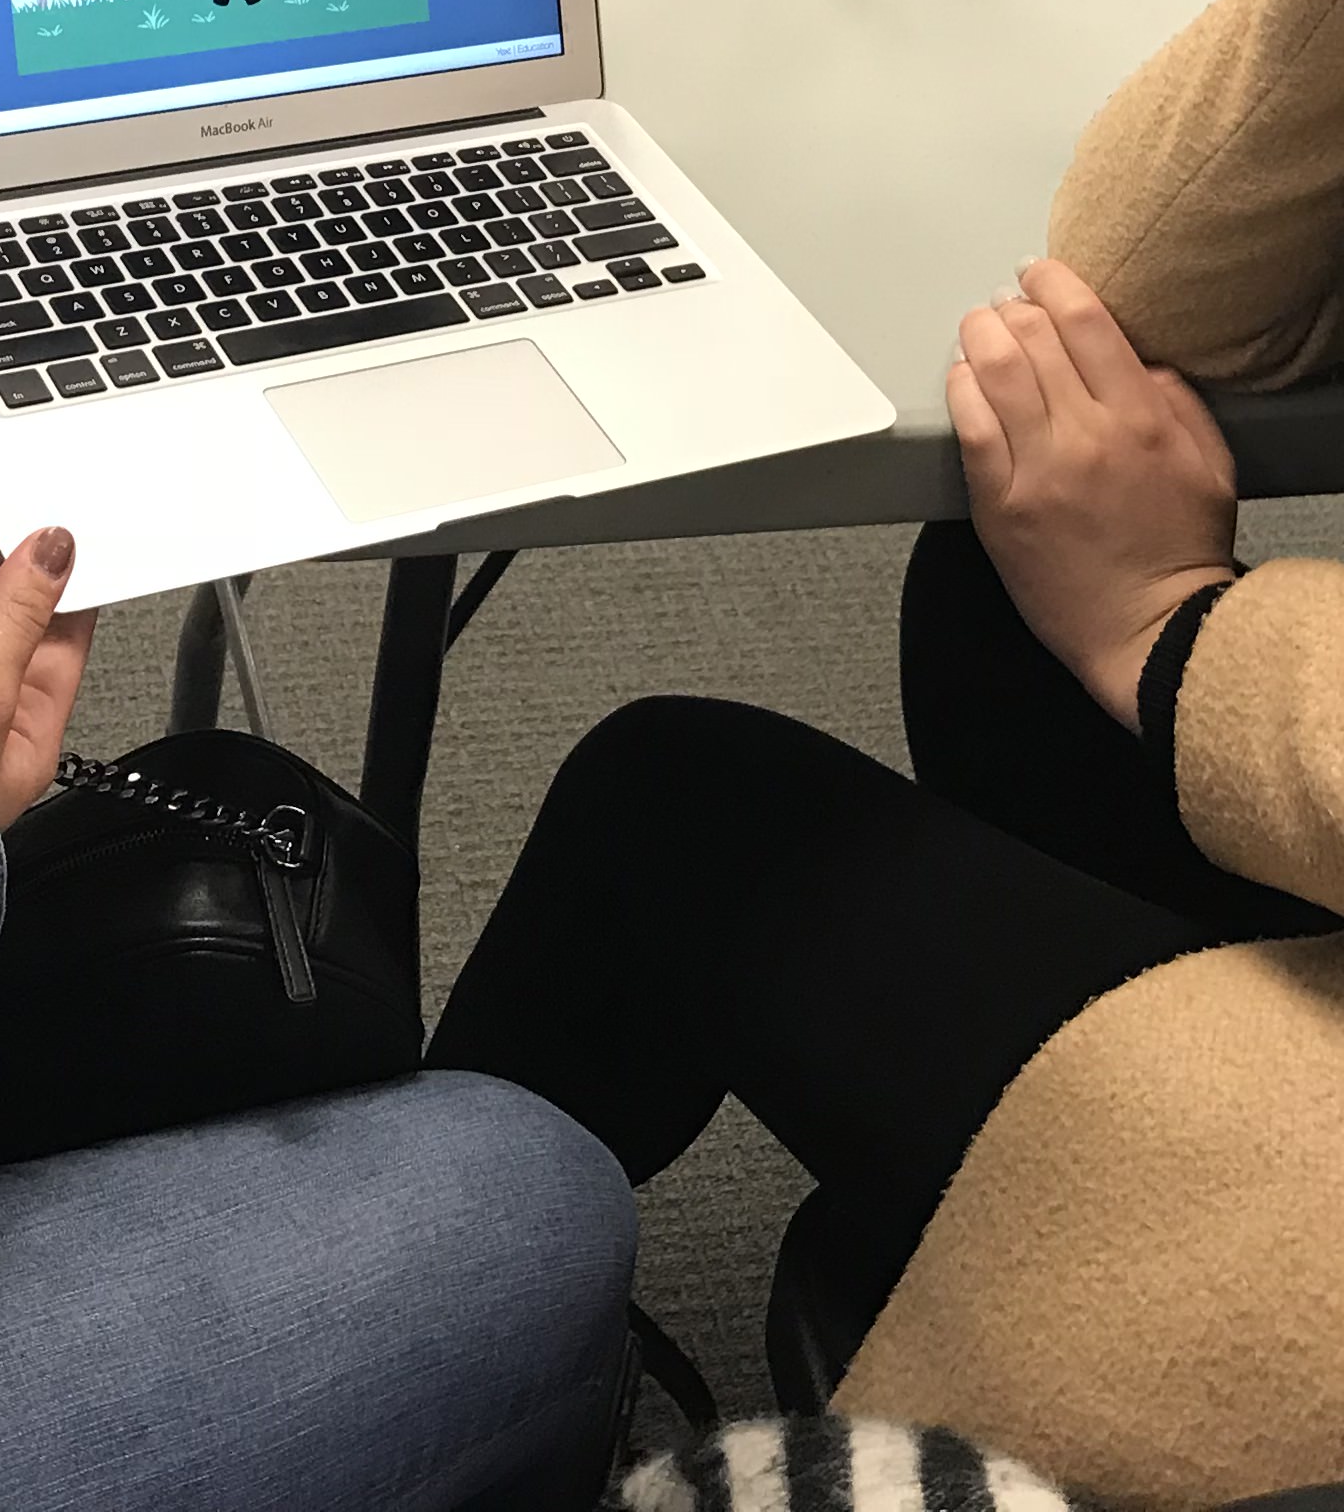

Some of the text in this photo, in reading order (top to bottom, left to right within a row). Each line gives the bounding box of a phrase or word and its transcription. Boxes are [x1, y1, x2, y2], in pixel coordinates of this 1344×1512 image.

[517, 41, 555, 54] Education
[200, 116, 274, 138] MacBook Air
[471, 201, 481, 211] P
[334, 223, 347, 234] U
[287, 232, 298, 242] Y
[460, 233, 472, 243] L
[240, 239, 250, 250] T
[413, 241, 427, 251] K
[52, 246, 63, 256] 2
[191, 248, 204, 259] R
[143, 256, 154, 267] E
[320, 257, 334, 268] H
[89, 264, 105, 276] W
[272, 266, 285, 276] G
[40, 274, 55, 284] Q
[224, 274, 234, 285] F
[411, 272, 427, 284] M
[173, 283, 186, 294] D
[364, 281, 378, 292] N
[123, 291, 135, 302] S
[317, 290, 329, 301] B
[73, 301, 85, 312] A
[267, 298, 278, 309] V
[218, 308, 231, 318] C
[167, 316, 181, 328] X
[116, 325, 128, 337] Z
[172, 357, 217, 371] command
[64, 378, 97, 391] control
